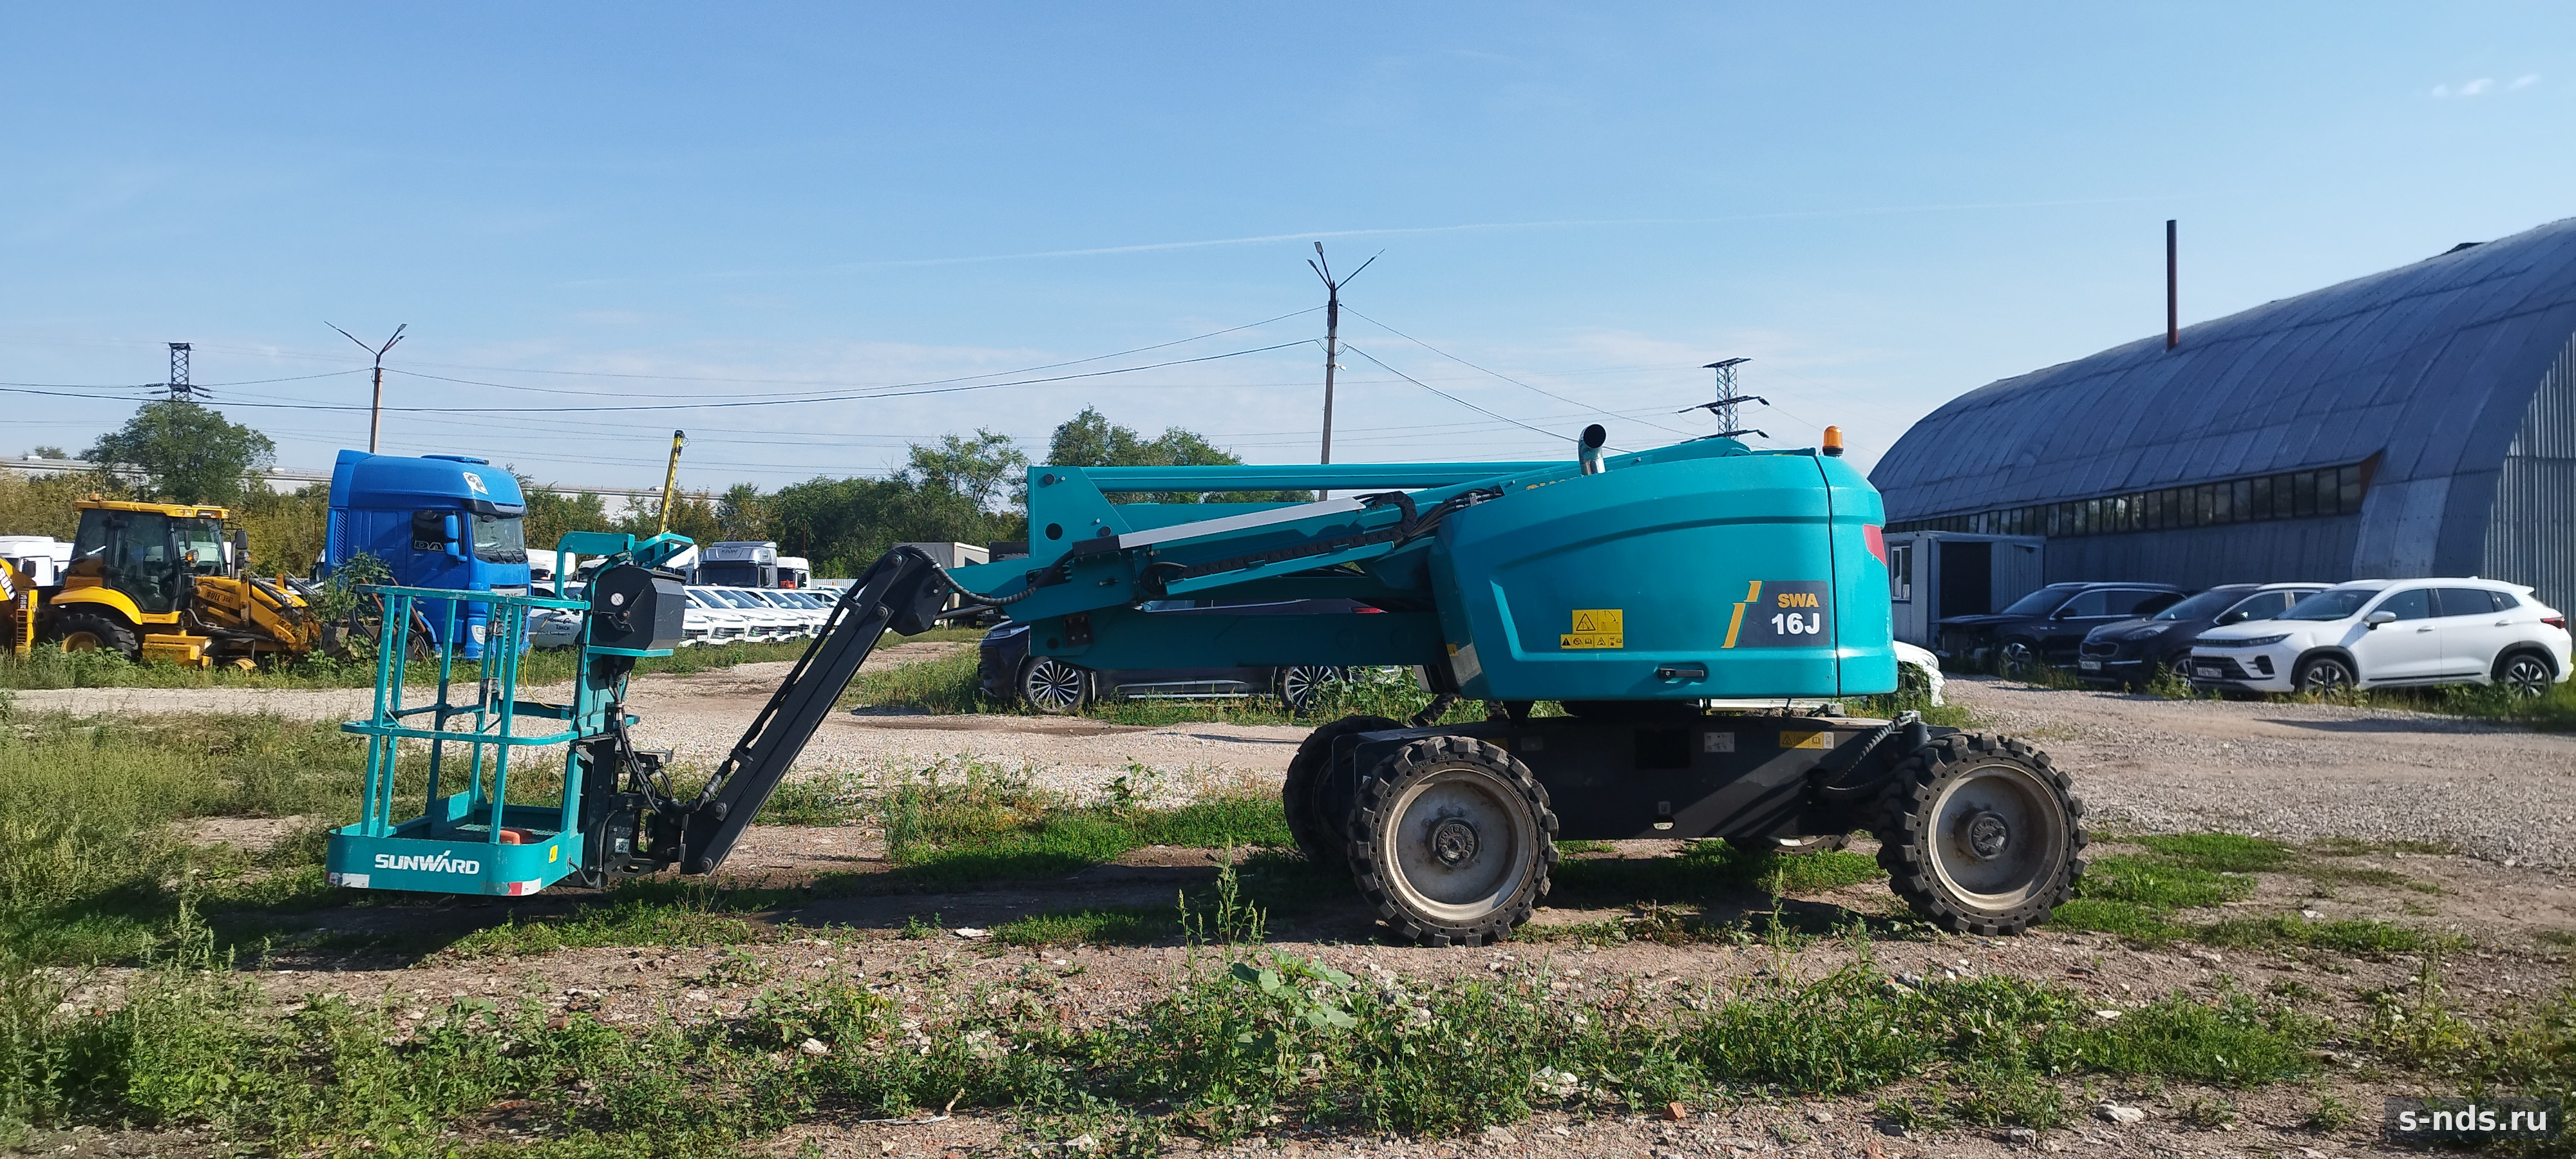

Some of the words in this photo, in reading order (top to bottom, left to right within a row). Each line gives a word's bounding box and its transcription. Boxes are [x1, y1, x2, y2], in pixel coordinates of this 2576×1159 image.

[415, 540, 446, 551] DA
[1777, 593, 1821, 608] SWA
[1771, 612, 1820, 635] 16J
[374, 850, 480, 874] SUNWARD
